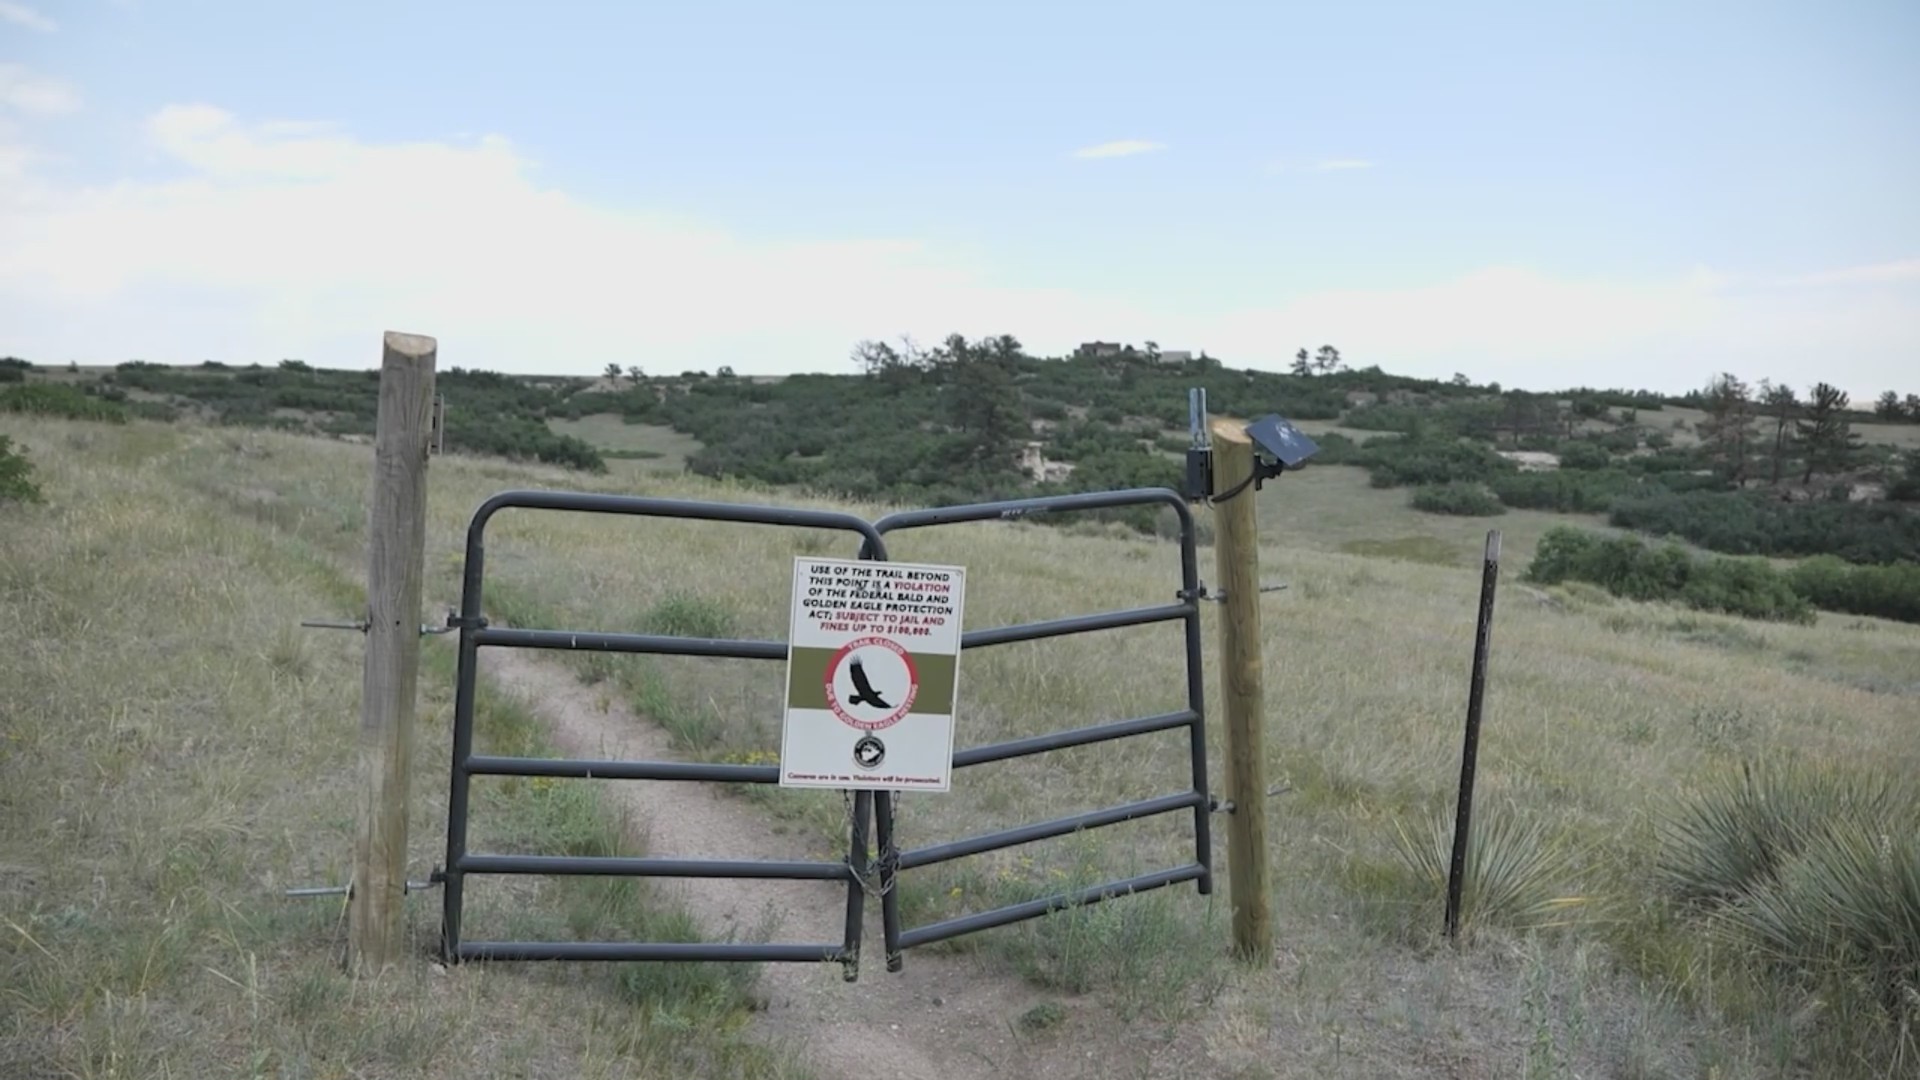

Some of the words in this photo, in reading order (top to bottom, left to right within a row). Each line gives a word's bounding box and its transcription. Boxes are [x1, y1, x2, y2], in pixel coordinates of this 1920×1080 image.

[811, 565, 830, 574] USE
[834, 567, 847, 575] OF
[852, 568, 872, 577] THE
[876, 570, 903, 579] TRAIL
[907, 573, 949, 581] BEYOND
[810, 577, 832, 585] THIS
[837, 578, 868, 588] POINT
[872, 580, 881, 588] IS
[894, 582, 950, 592] VIOLATION
[808, 588, 821, 596] OF
[826, 589, 846, 597] THE
[850, 591, 893, 601] FEDERAL
[897, 594, 923, 602] BALD
[926, 595, 948, 603] AND
[803, 599, 846, 609] GOLDEN
[850, 601, 881, 611] EAGLE
[886, 603, 953, 615] PROTECTION
[809, 611, 832, 620] ACT;
[836, 612, 878, 621] SUBJECT
[883, 614, 897, 622] TO
[900, 616, 919, 624] JAIL
[922, 617, 945, 625] AND
[820, 622, 849, 631] FINES
[853, 623, 866, 631] UP
[870, 624, 884, 632] TO
[848, 638, 871, 651] TRAIL
[873, 638, 905, 655] CLOSED
[825, 683, 834, 700] DUE
[831, 702, 840, 713] TO
[839, 708, 871, 729] GOLDEN
[873, 714, 898, 729] EAGLE
